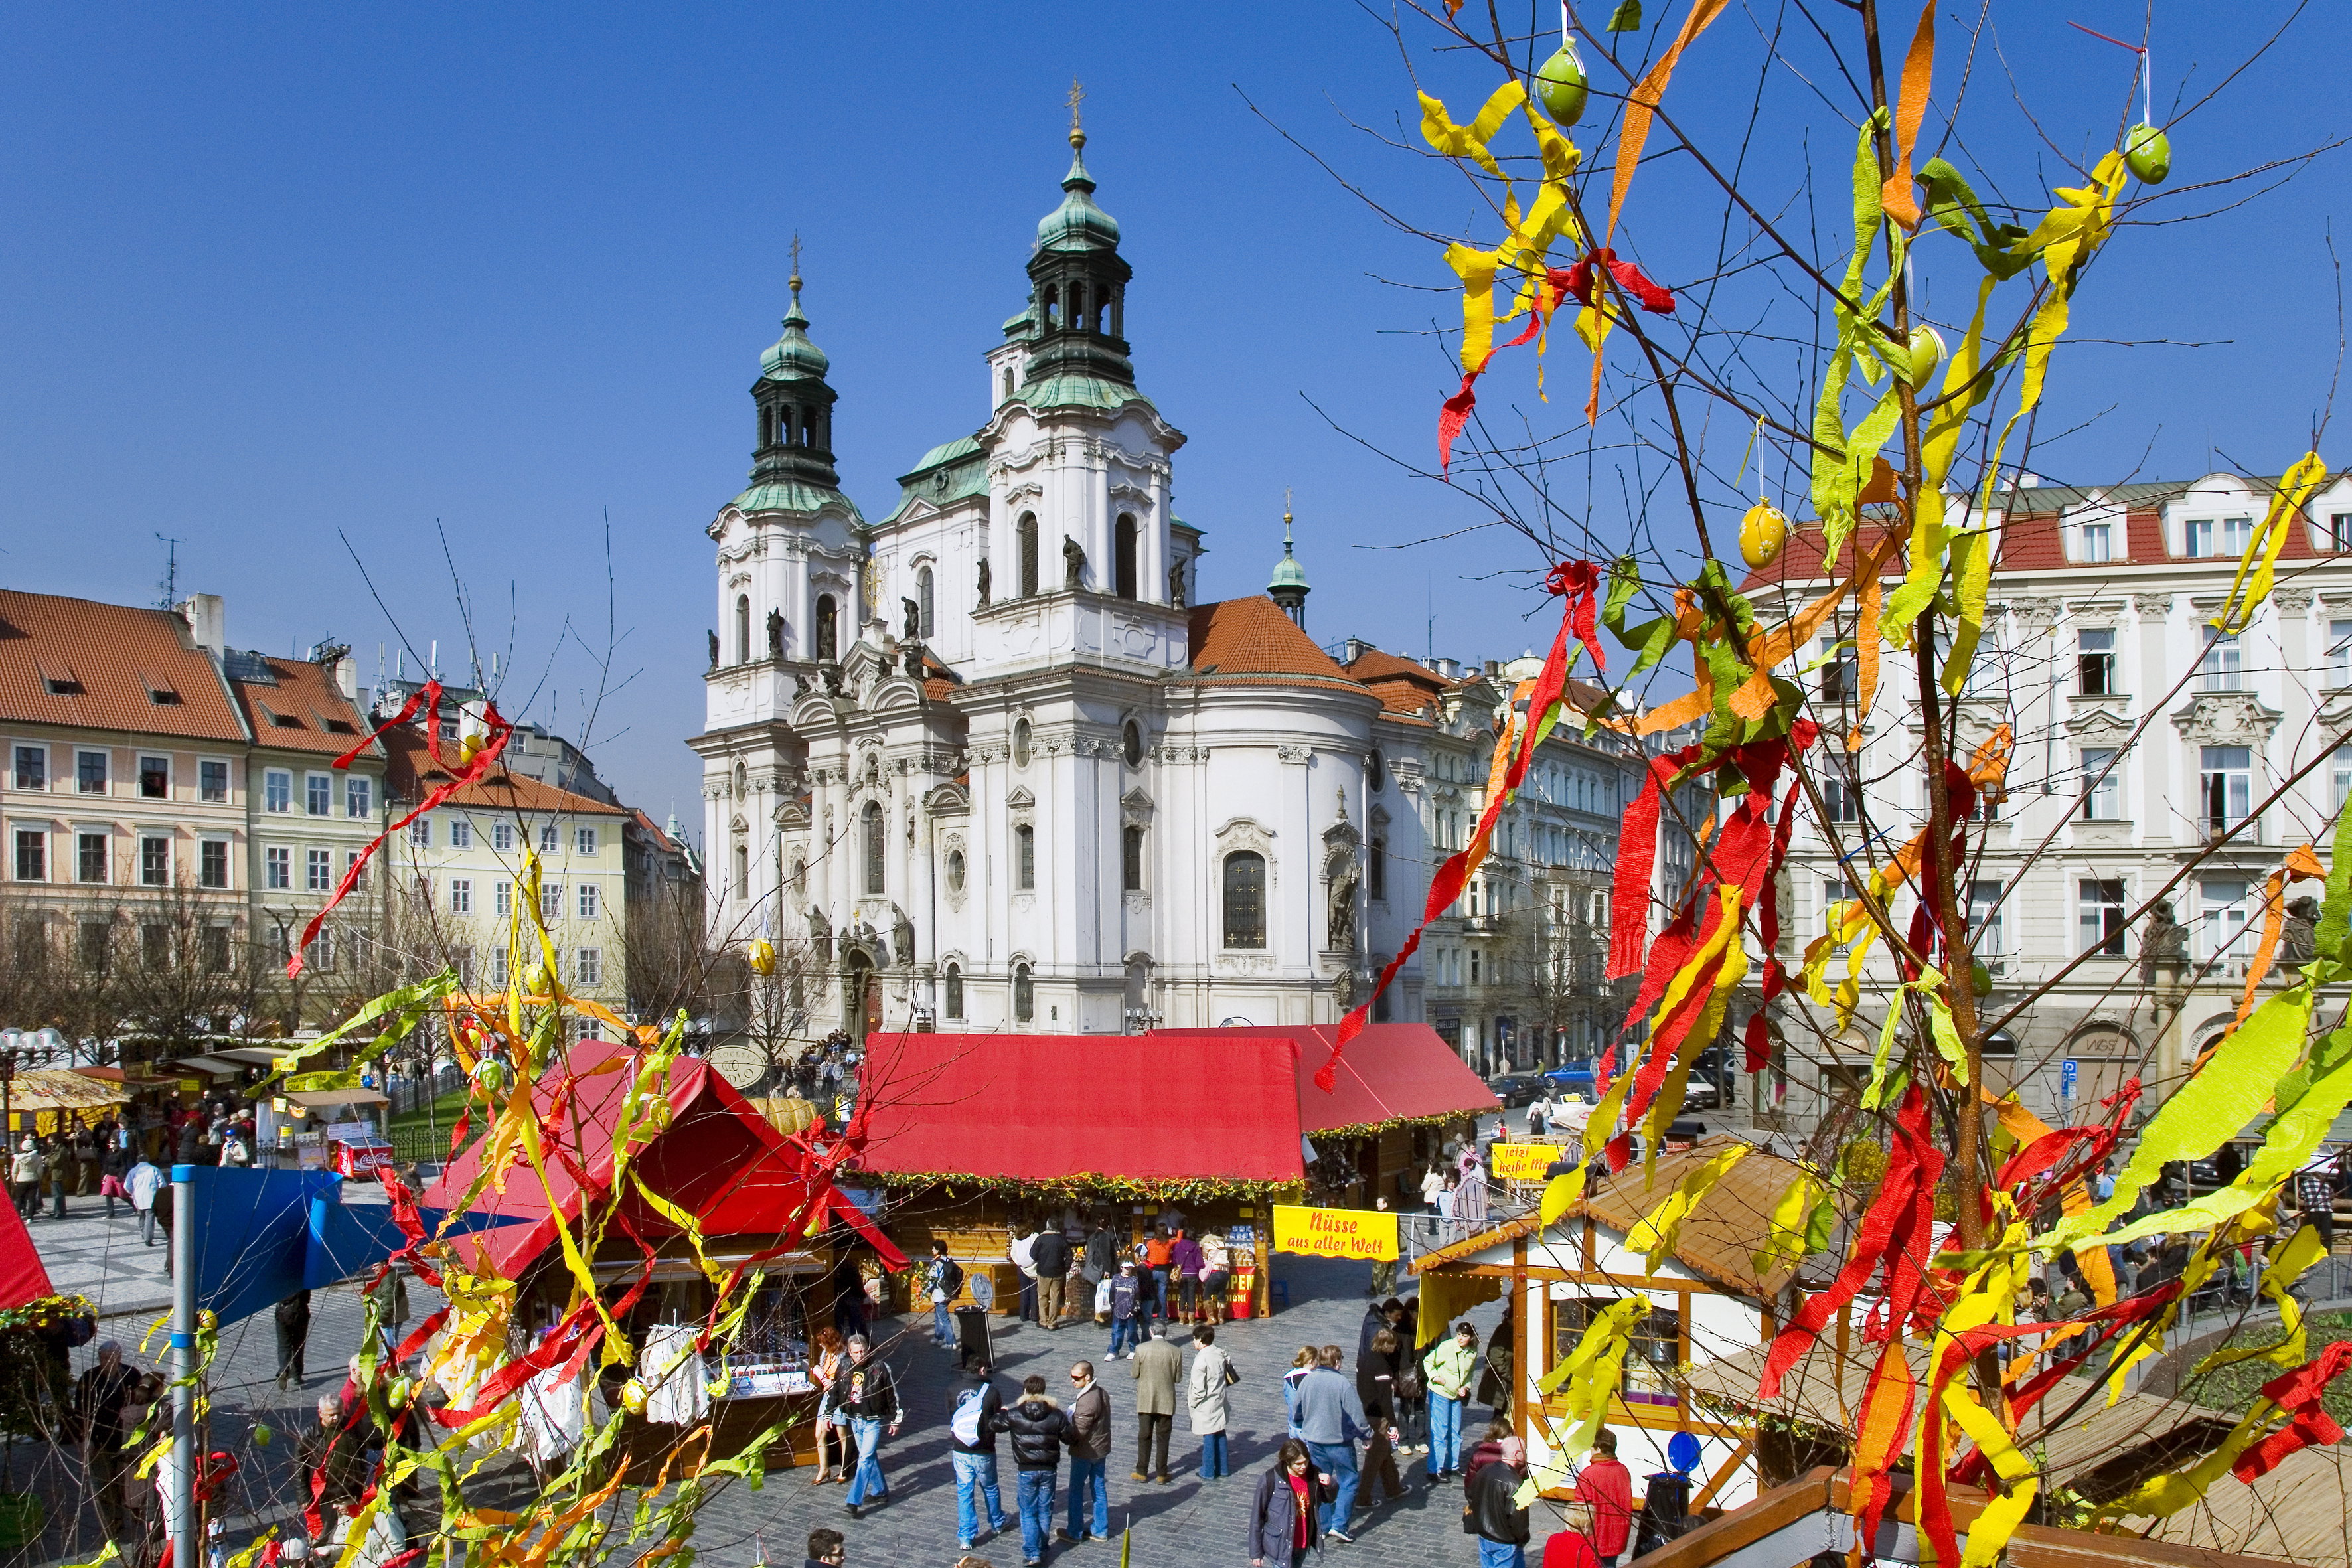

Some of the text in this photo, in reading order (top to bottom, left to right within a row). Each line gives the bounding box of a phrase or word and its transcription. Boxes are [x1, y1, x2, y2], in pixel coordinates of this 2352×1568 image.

[1437, 1020, 1458, 1029] EWELLERY
[722, 1069, 754, 1085] DLO
[1505, 1146, 1529, 1158] jetzt
[1499, 1160, 1526, 1174] heiße
[1310, 1211, 1358, 1234] Nüsse
[1287, 1235, 1383, 1254] aus aller Welt
